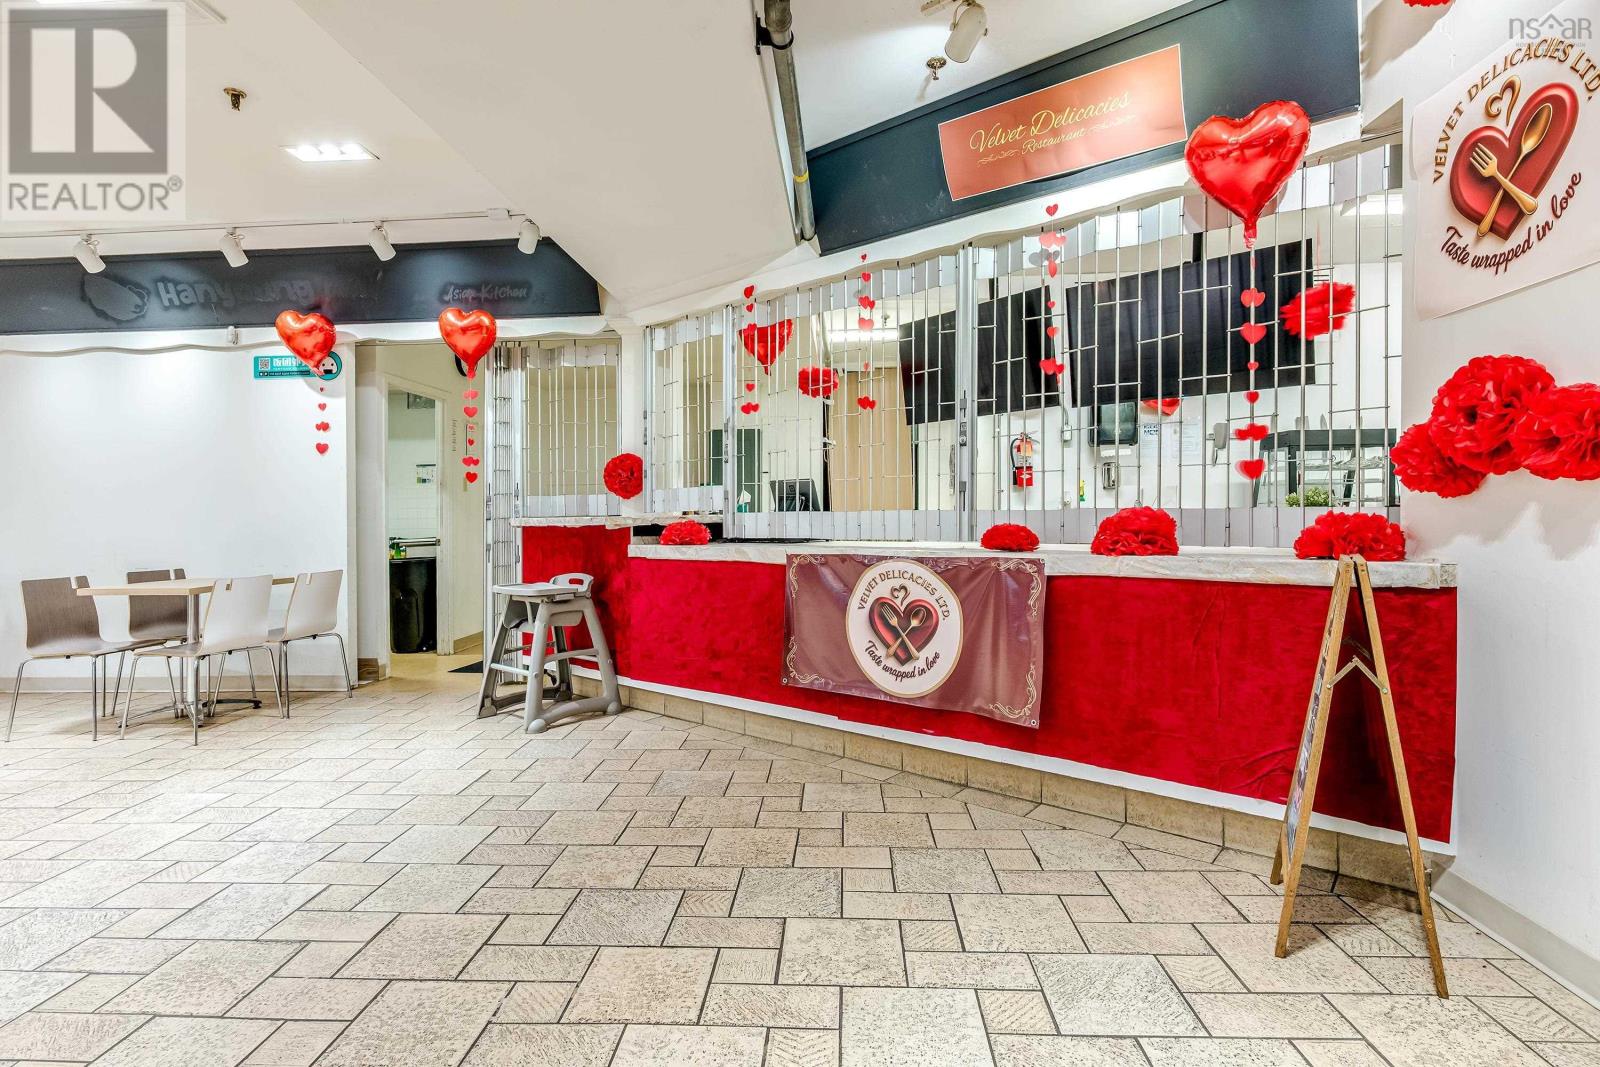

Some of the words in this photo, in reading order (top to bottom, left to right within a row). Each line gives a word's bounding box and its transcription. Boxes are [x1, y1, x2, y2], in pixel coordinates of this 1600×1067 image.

[969, 123, 1026, 153] Velvet
[1030, 91, 1131, 136] Delicacies
[1433, 101, 1464, 184] VELVET
[1467, 36, 1575, 103] DELICACIES
[1569, 48, 1600, 102] LTD.
[1022, 128, 1086, 154] Restaurant
[1440, 225, 1470, 266] Taste
[1471, 233, 1533, 275] wrapped
[1536, 219, 1554, 242] in
[1551, 172, 1582, 219] love
[858, 577, 878, 610] VELVET
[878, 569, 937, 596] DELICACIES
[935, 595, 951, 621] LTD.
[865, 640, 883, 666] Taste
[882, 664, 917, 682] wrapped
[917, 664, 927, 677] in
[925, 651, 940, 671] love
